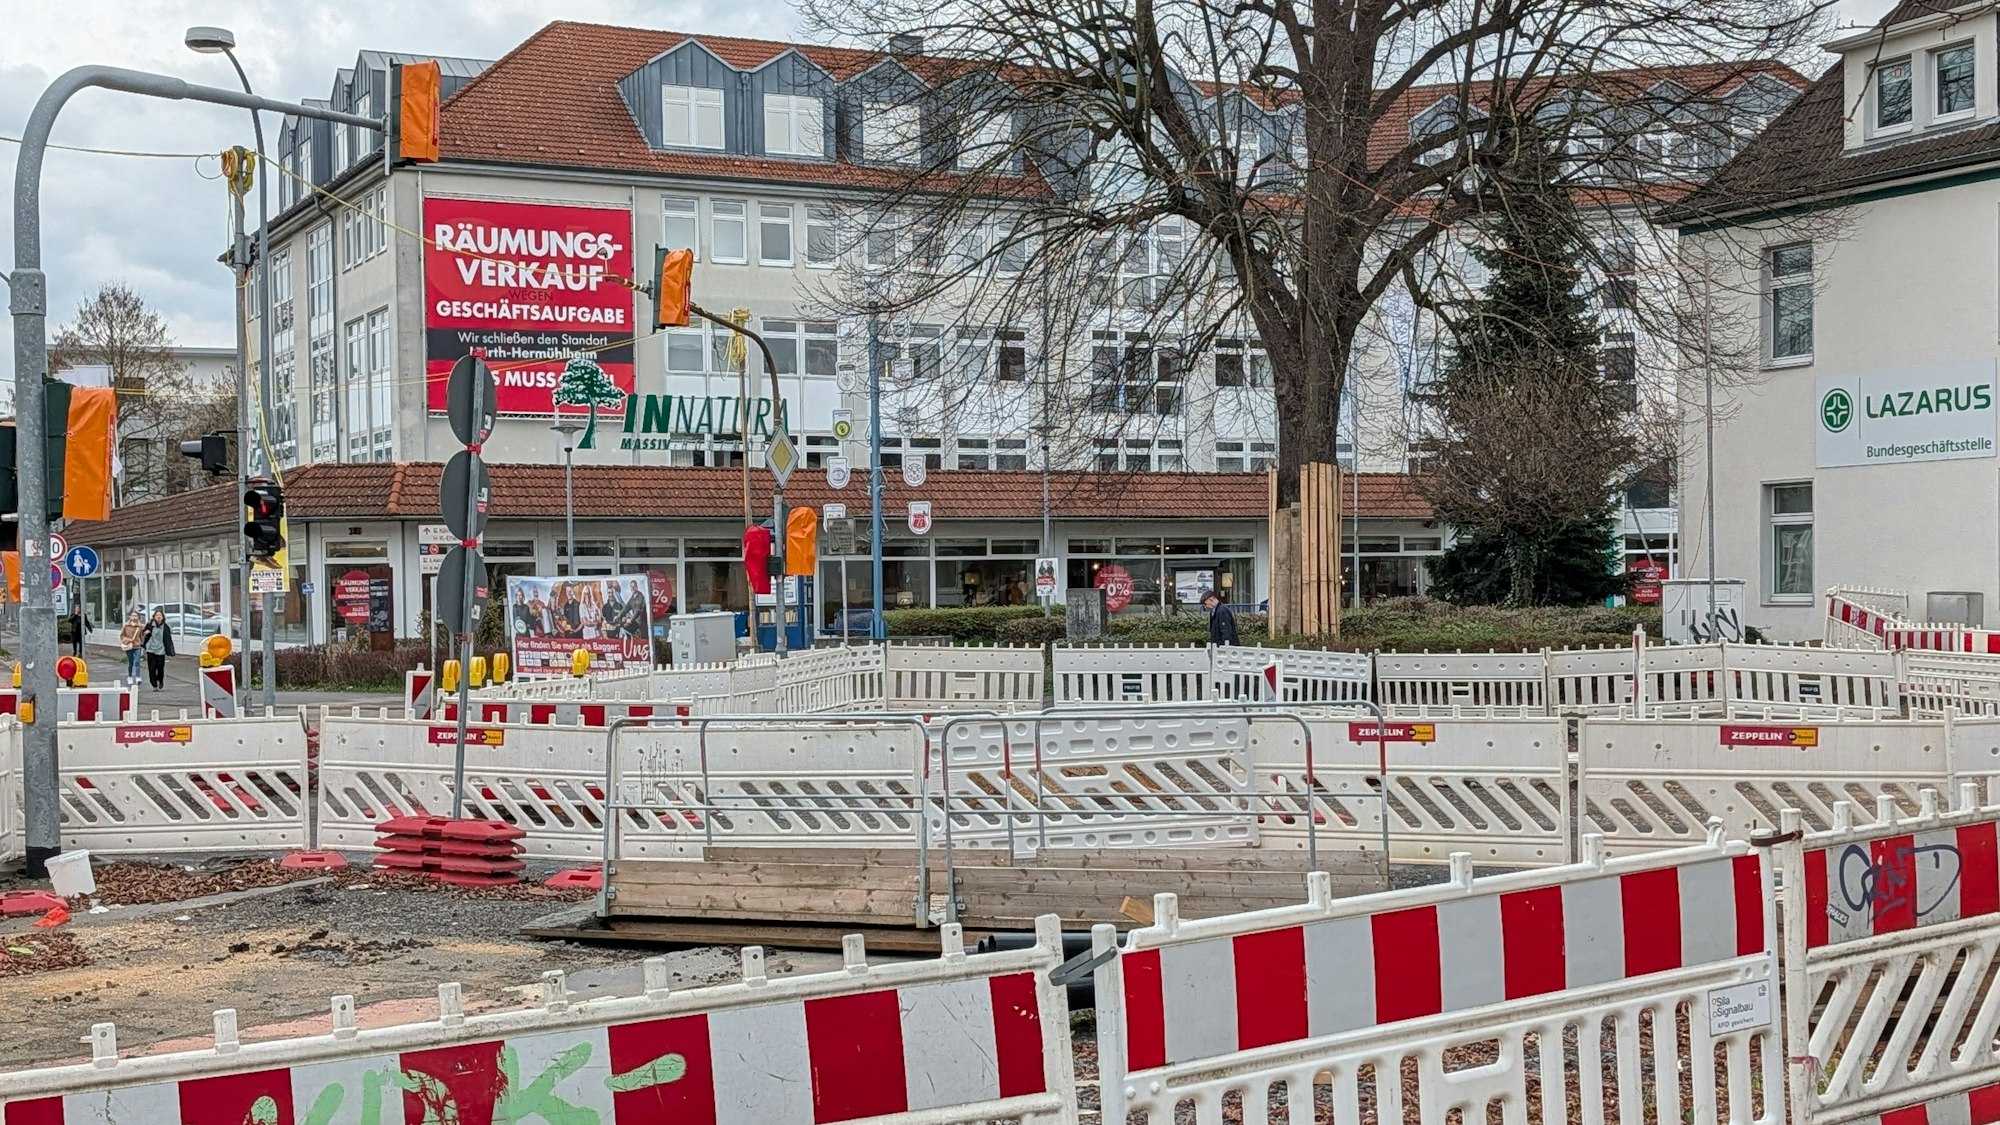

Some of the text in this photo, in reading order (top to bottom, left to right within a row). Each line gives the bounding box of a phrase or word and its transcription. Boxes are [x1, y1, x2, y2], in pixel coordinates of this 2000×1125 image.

[435, 222, 622, 260] RÄUMUNGS-
[455, 258, 603, 291] VERKAUF
[508, 290, 554, 301] WEGEN
[436, 299, 625, 324] GESCHÄFTSAUFGABE
[457, 332, 608, 346] Wir schließen den Standort
[504, 371, 556, 388] MUSS
[1866, 384, 1991, 418] LAZARUS
[1866, 437, 1992, 458] Bundesgeschäftsstelle
[124, 730, 166, 739] ZEPPELIN
[1731, 731, 1783, 740] ZEPPELIN
[1716, 1003, 1754, 1018] Signalbau
